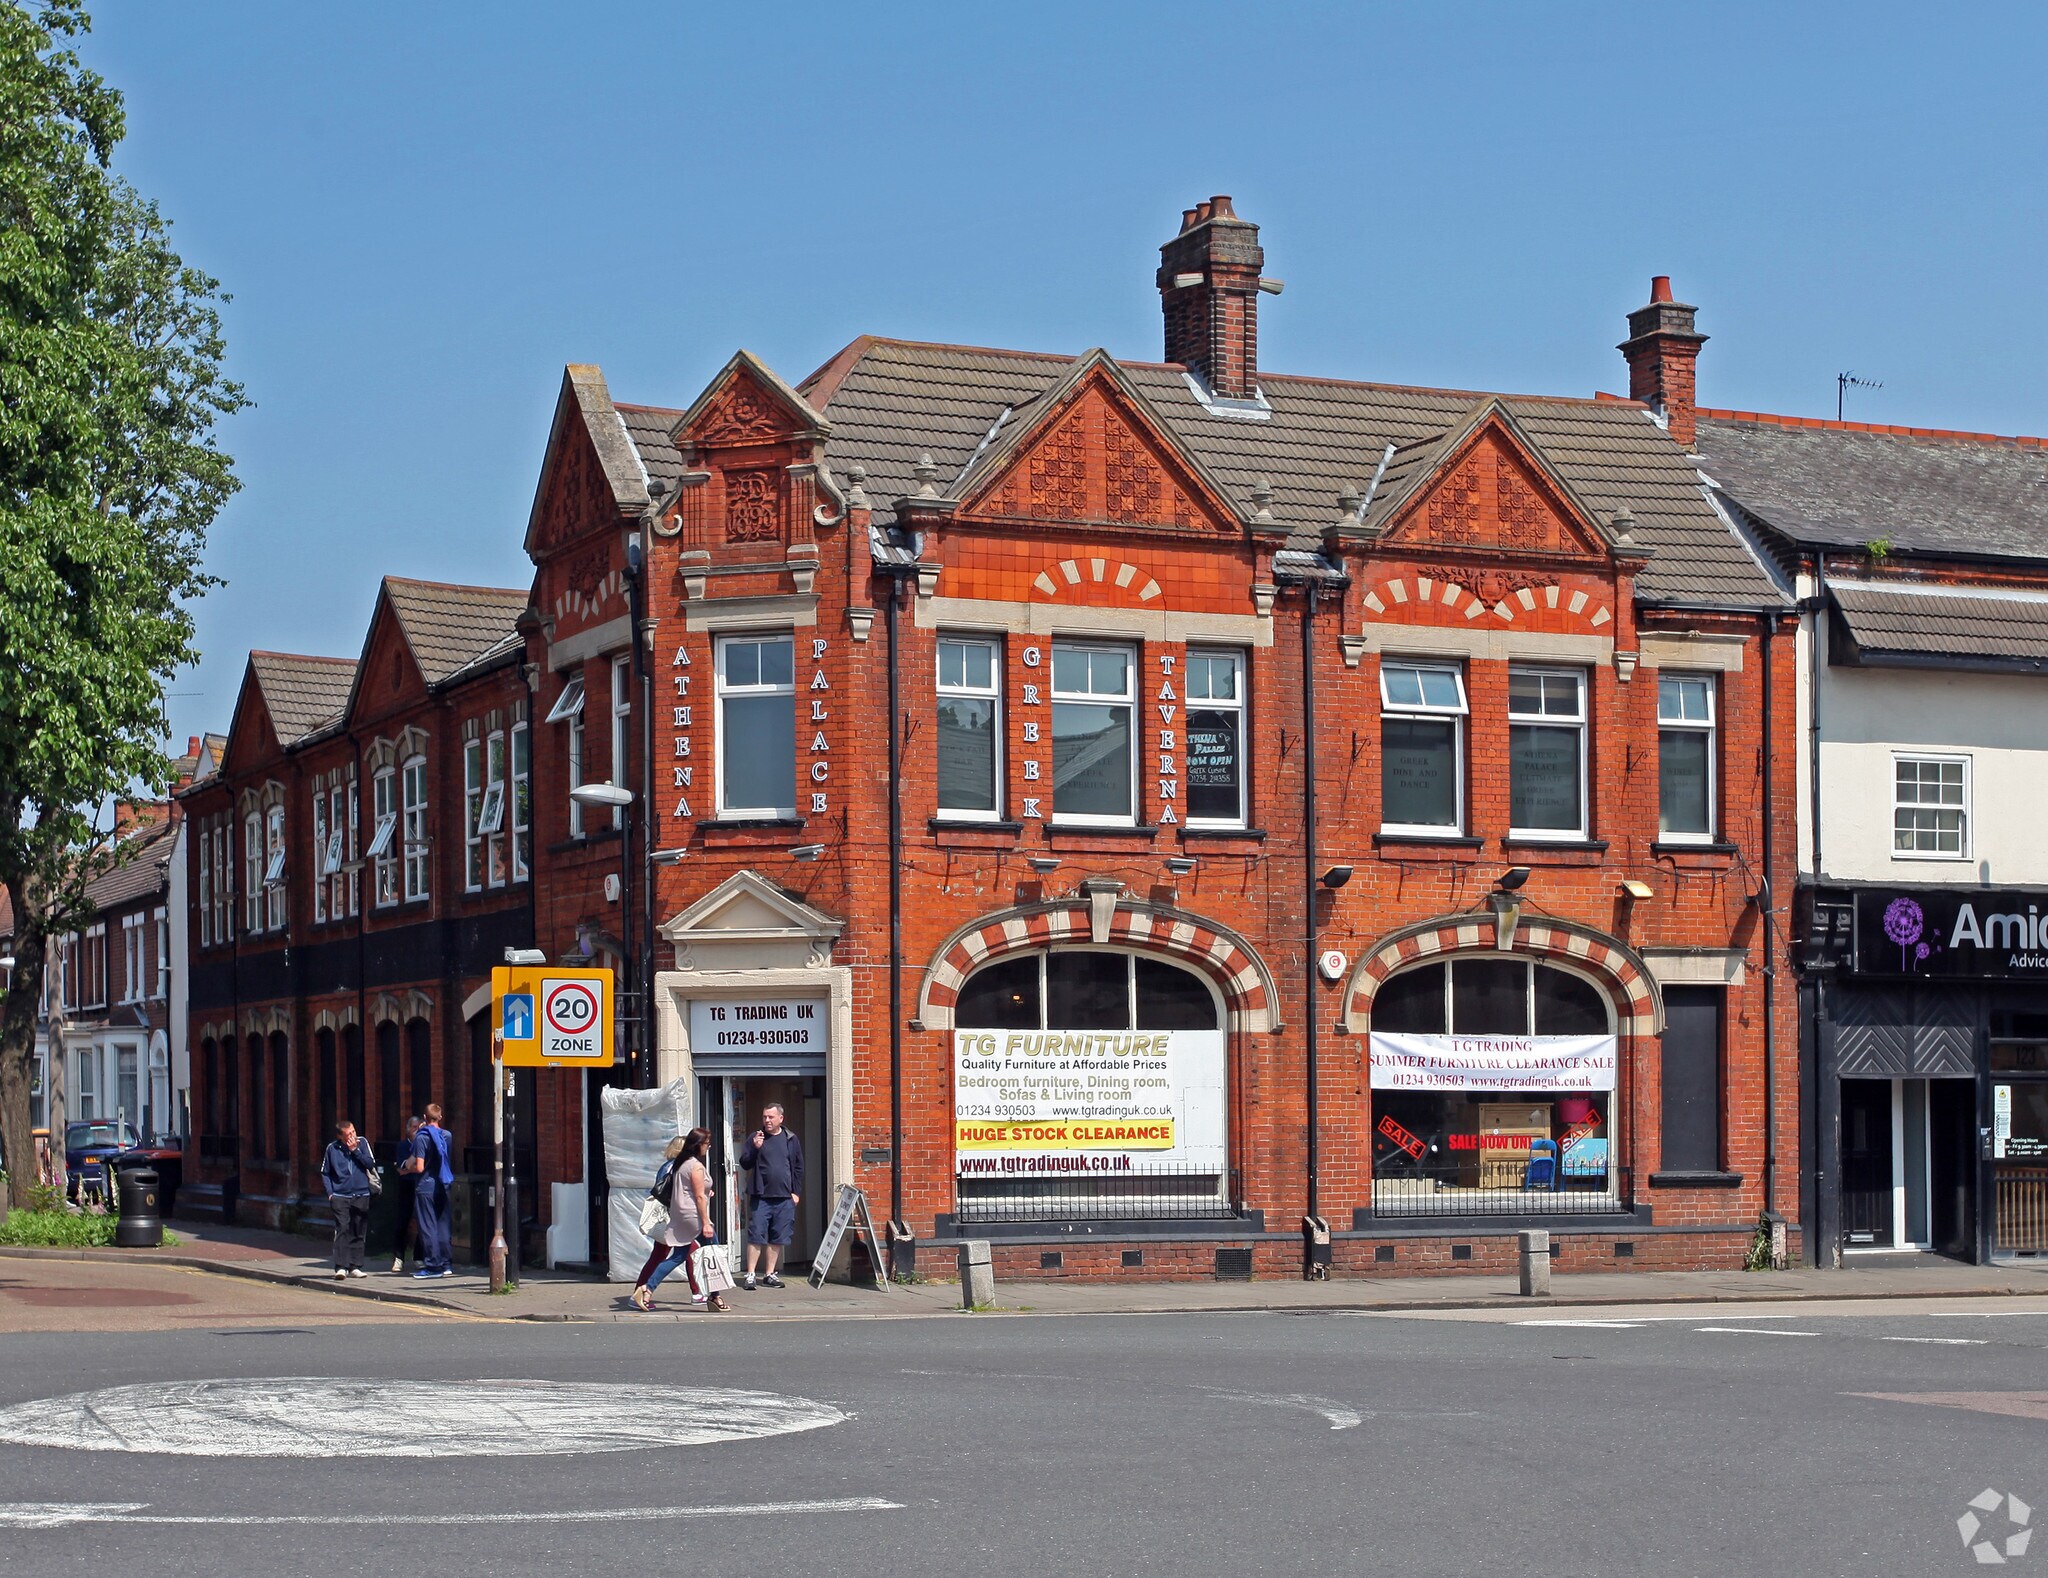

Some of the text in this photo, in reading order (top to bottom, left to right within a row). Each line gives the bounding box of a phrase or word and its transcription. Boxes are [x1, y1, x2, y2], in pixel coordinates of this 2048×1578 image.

[673, 646, 692, 817] ATHENA
[811, 639, 829, 813] PALACE
[1023, 647, 1042, 818] GREEK
[1159, 655, 1178, 824] TAVERNA
[555, 999, 589, 1019] 20
[710, 1005, 814, 1021] TG TRADING UK
[551, 1039, 593, 1052] ZONE
[717, 1029, 809, 1046] 01234-930503
[958, 1033, 1169, 1057] TG FURNITURE
[1476, 1040, 1532, 1053] TRADING
[1370, 1055, 1614, 1069] SUMMER FURNITURE CLEARANCE SALE
[2015, 1046, 2036, 1065] 123
[961, 1059, 1167, 1072] Quality Furniture at Affordable Prices
[959, 1075, 1170, 1090] Bedroom furniture, Dining room,
[1393, 1074, 1592, 1089] 01234 930503 www.tgtradinguk.co.uk
[999, 1089, 1132, 1103] Sofas & Living room
[957, 1105, 1172, 1118] 01234 930503 www.tgtradinguk.co.uk
[960, 1127, 1170, 1141] HUGE STOCK CLEARANCE
[1382, 1120, 1421, 1154] SALE
[1562, 1114, 1598, 1149] SALE
[1448, 1134, 1477, 1150] SALE
[1480, 1135, 1508, 1149] NOW
[960, 1155, 1131, 1173] www.tgtradinguk.co.uk
